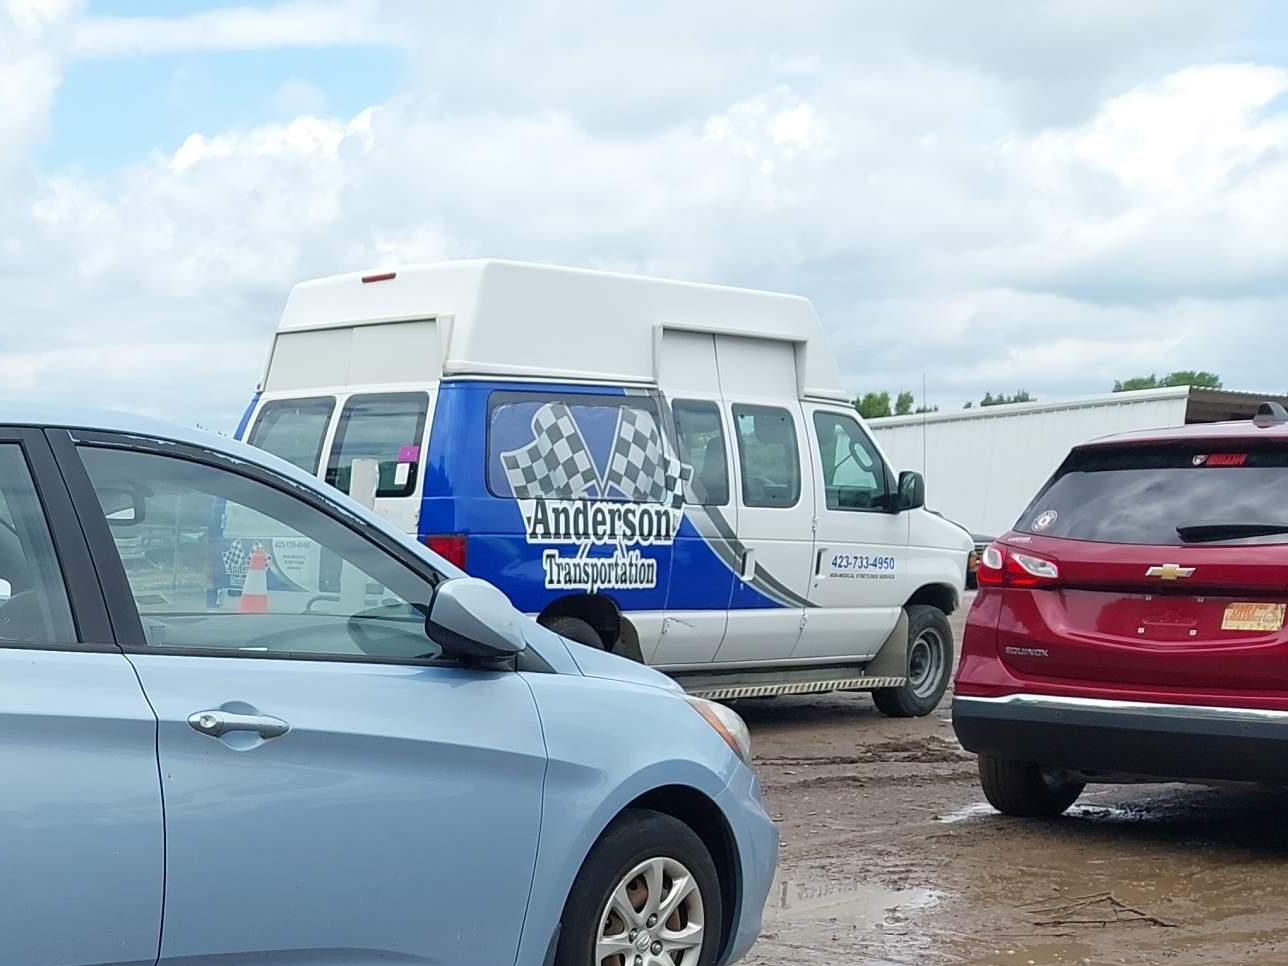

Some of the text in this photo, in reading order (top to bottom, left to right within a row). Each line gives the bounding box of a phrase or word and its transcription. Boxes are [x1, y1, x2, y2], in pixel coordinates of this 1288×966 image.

[529, 496, 672, 541] Anderson
[545, 553, 655, 594] Transportation
[831, 555, 895, 570] 423-733-4950
[1005, 646, 1049, 657] EQUINOX
